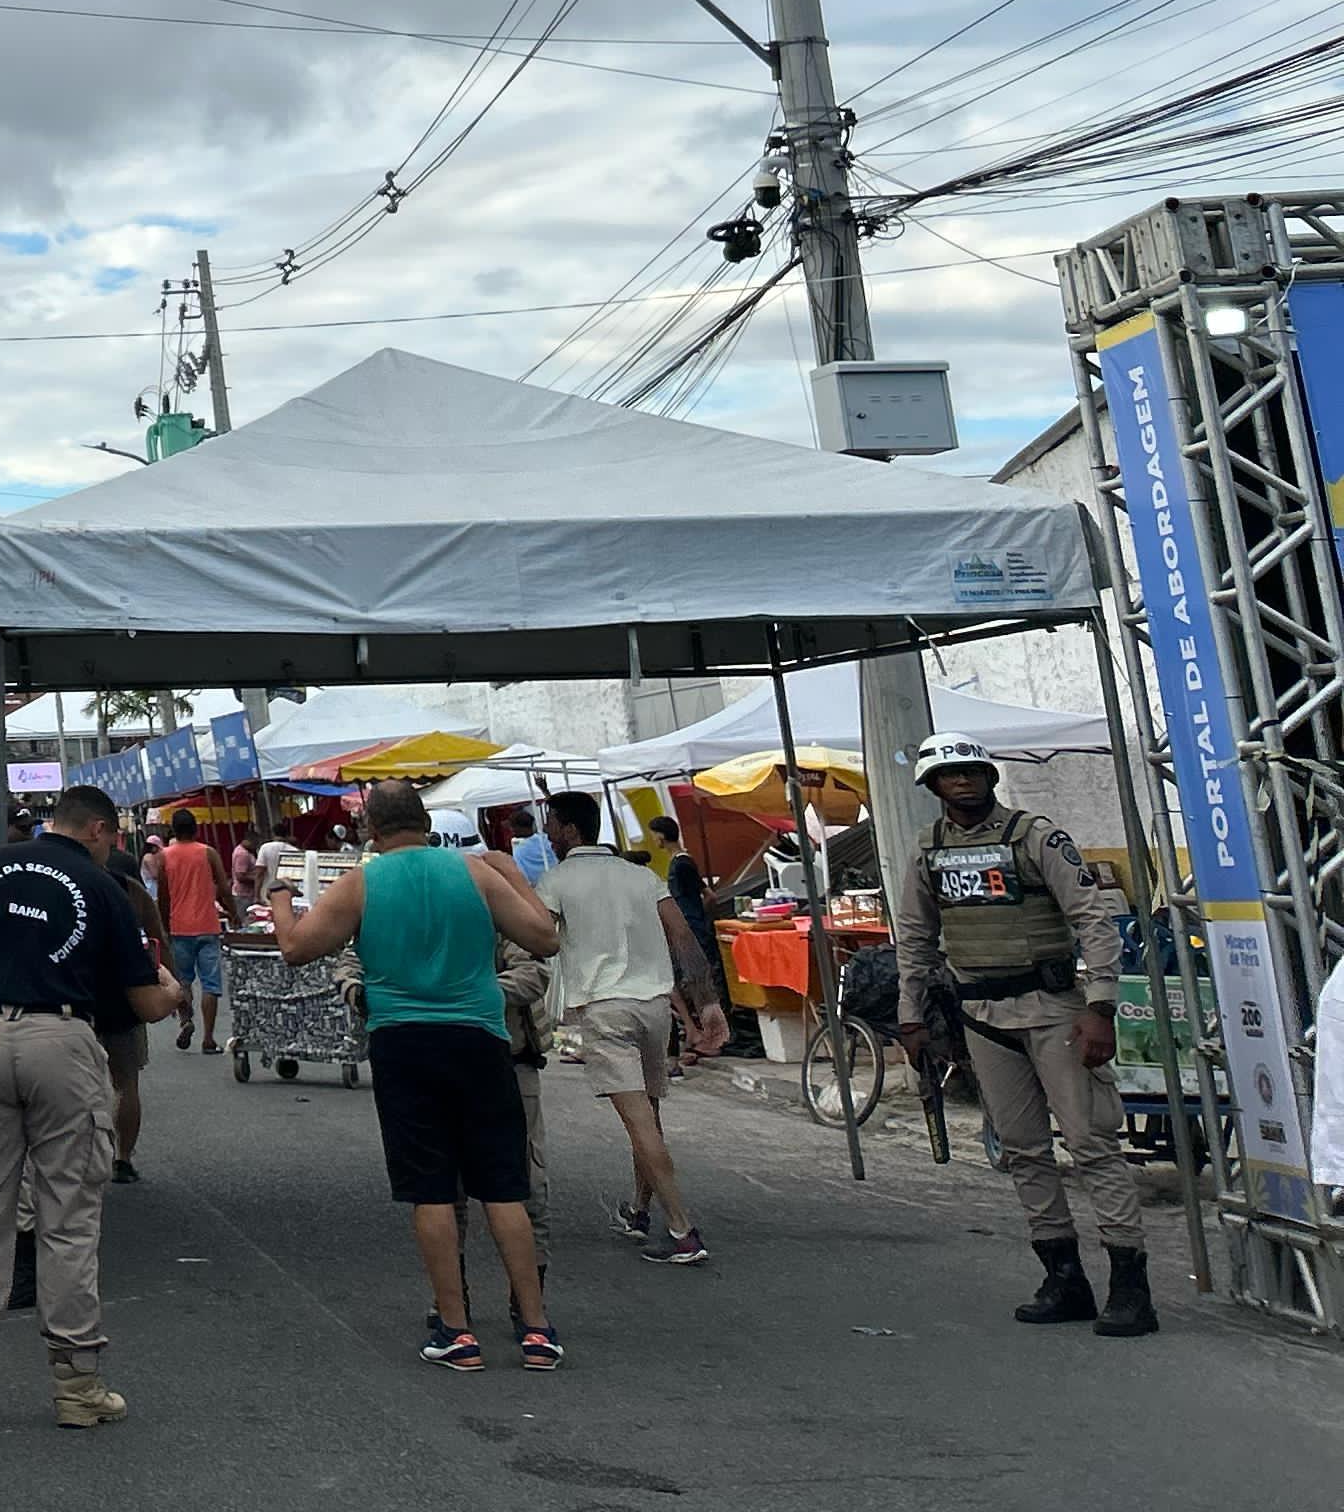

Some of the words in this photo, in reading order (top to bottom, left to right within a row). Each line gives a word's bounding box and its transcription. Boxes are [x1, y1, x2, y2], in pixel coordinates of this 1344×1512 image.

[1127, 364, 1192, 624] ABORDAGEM
[1179, 634, 1205, 691] DE
[1192, 699, 1235, 868] PORTAL
[2, 863, 23, 875] DA
[25, 862, 87, 918] SEGURANÇA
[8, 902, 48, 922] BAHIA
